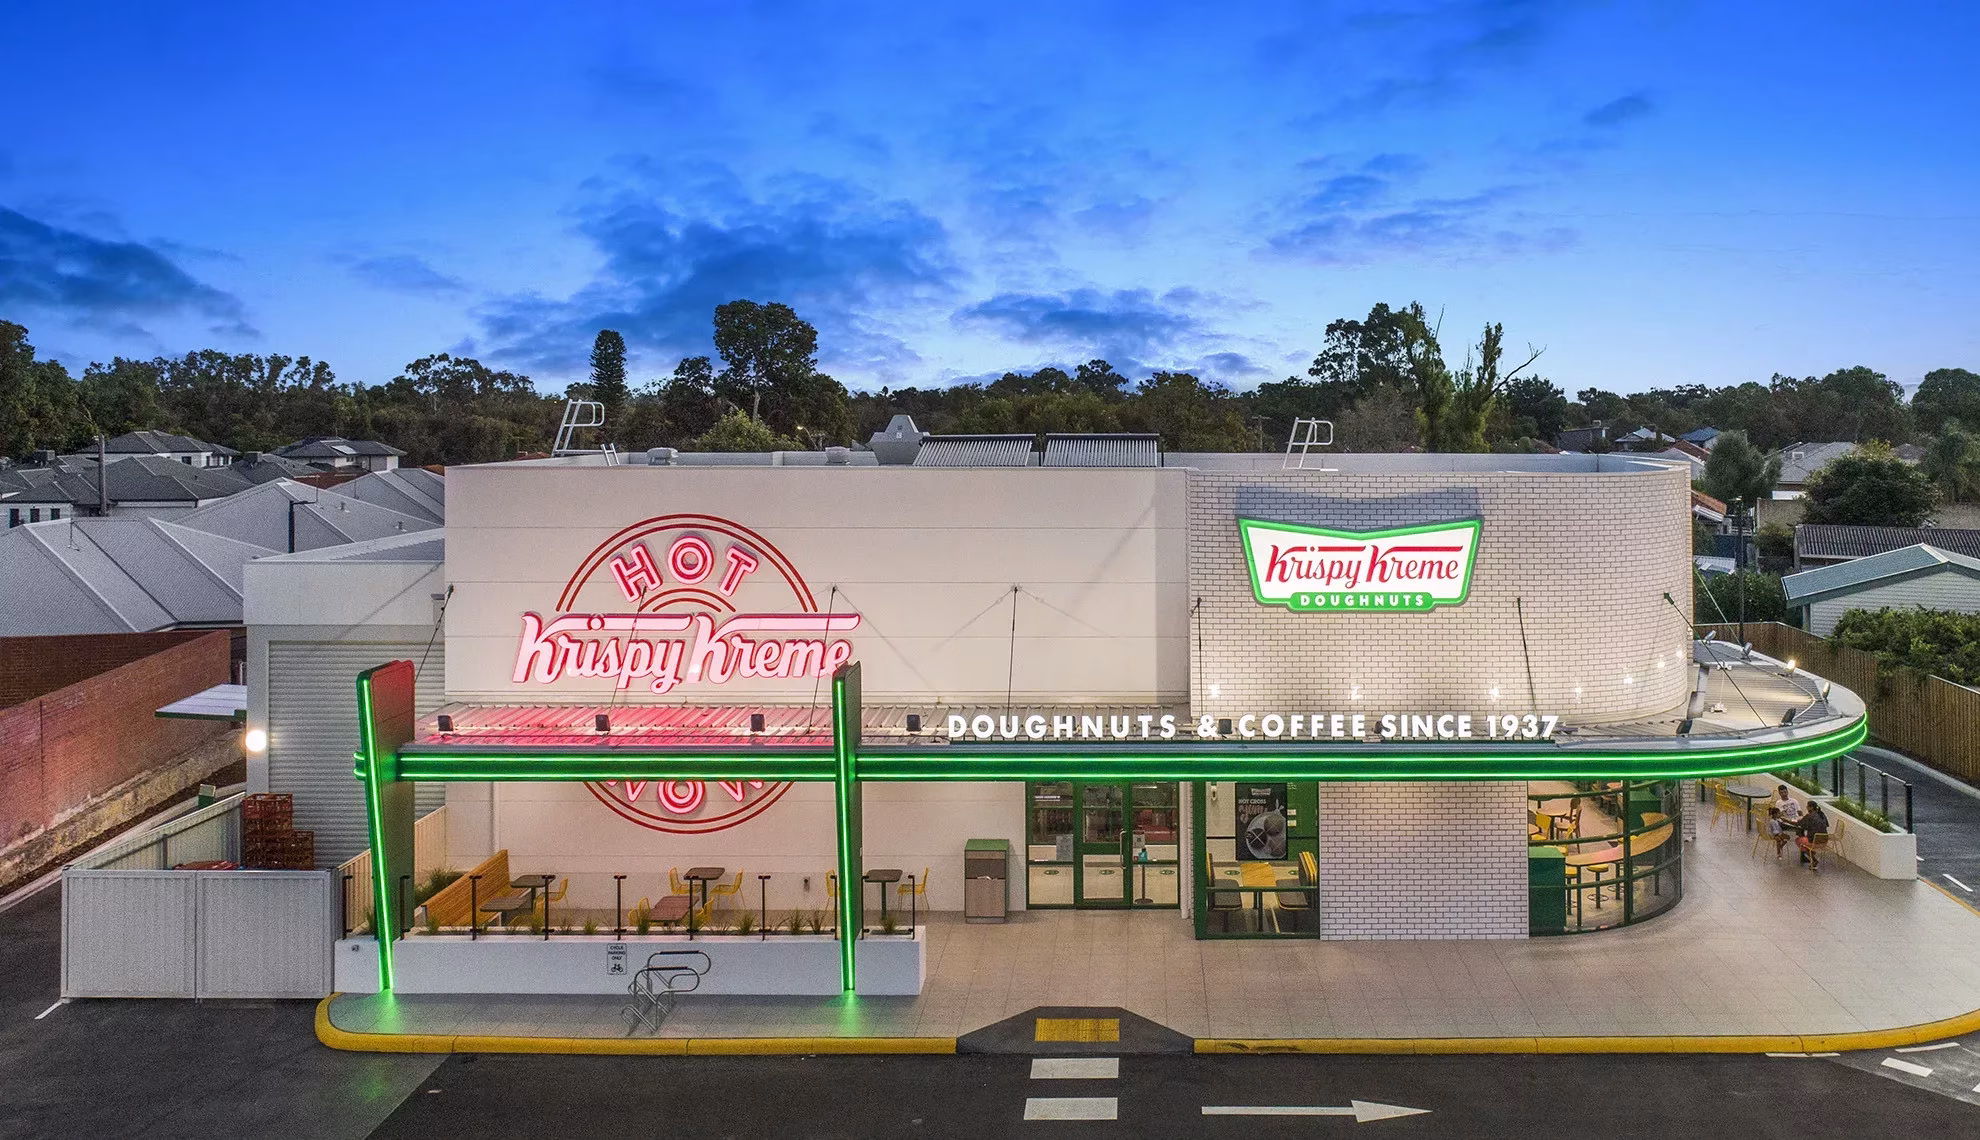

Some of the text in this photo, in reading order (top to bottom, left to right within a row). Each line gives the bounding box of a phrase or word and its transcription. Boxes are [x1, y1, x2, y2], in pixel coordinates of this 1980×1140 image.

[609, 535, 758, 602] HOT
[1265, 544, 1463, 589] Krispy Kreme
[1300, 594, 1424, 607] DOUGHNUTS
[512, 612, 861, 694] Krispy Kreme
[948, 714, 1559, 739] DOUGHNUTS & COFFEE SINCE 1937
